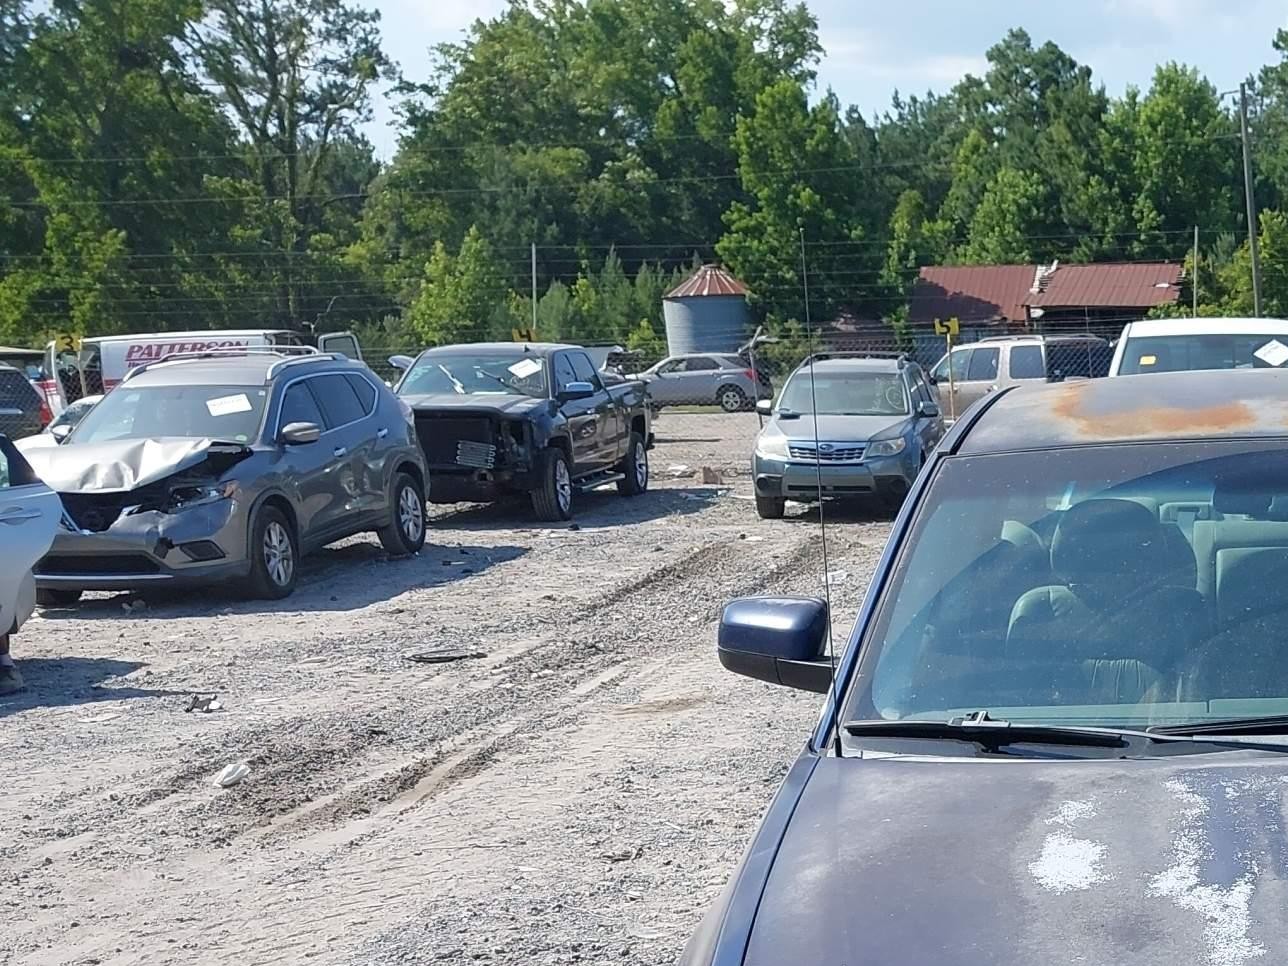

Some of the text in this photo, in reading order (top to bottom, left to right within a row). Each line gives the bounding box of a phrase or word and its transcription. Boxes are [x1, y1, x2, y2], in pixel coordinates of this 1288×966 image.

[517, 328, 532, 342] 4
[939, 318, 951, 335] 5
[60, 335, 75, 352] 3
